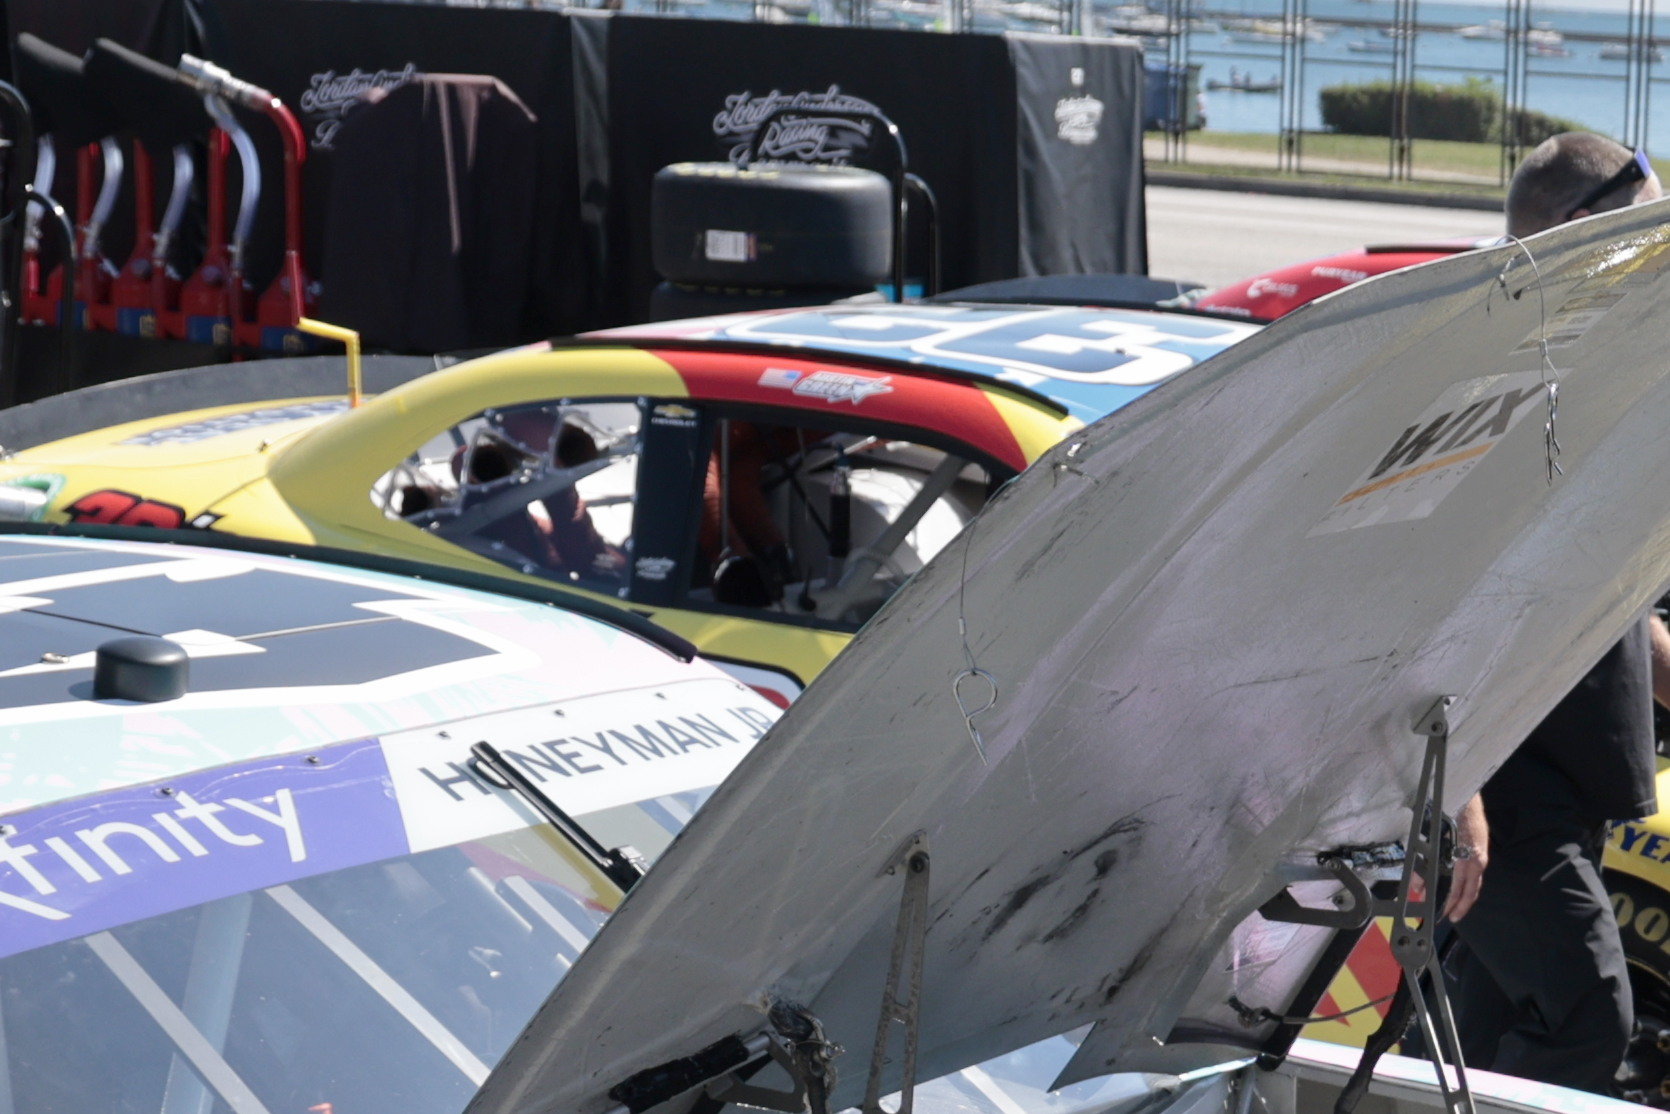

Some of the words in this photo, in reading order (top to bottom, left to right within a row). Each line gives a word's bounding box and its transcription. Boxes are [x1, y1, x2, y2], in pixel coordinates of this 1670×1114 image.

[1366, 378, 1556, 482] WIX
[1319, 459, 1477, 525] FILTERS
[418, 713, 741, 802] HNEYMAN
